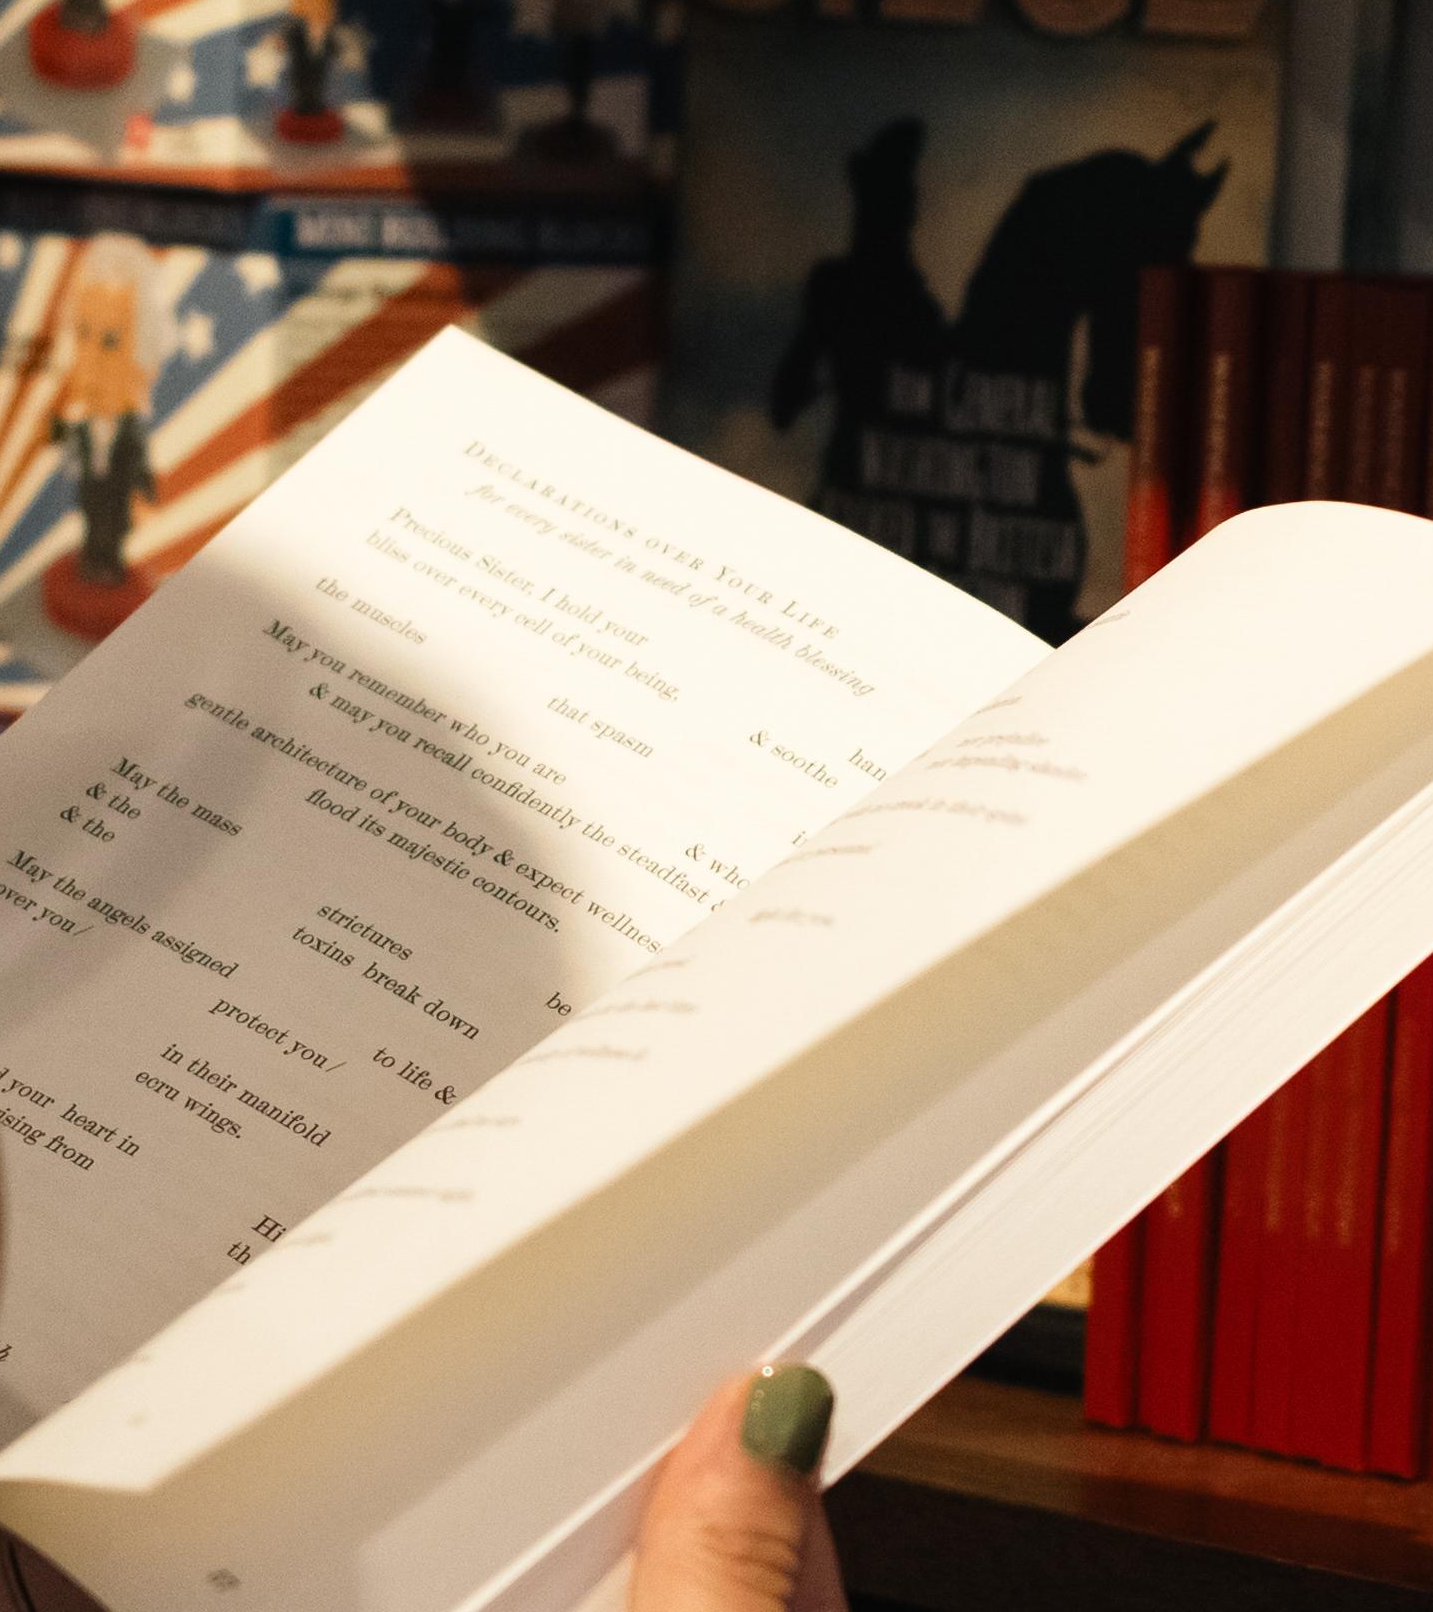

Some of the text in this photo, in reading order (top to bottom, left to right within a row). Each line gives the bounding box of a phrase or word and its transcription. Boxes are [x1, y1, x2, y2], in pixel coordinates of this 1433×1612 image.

[389, 506, 473, 561] Precious
[474, 555, 535, 596] Sister,
[553, 593, 604, 632] hold
[596, 620, 650, 647] your
[463, 440, 840, 640] DECLARATIONS OVER YOUR LIFE
[558, 532, 613, 560] sister
[613, 557, 638, 574] in
[639, 570, 692, 597] need
[687, 583, 717, 609] of
[729, 609, 795, 651] health
[794, 643, 876, 697] blessing
[262, 619, 310, 662] May
[303, 648, 347, 675] you
[346, 668, 448, 724] remember
[486, 741, 532, 769] you
[531, 762, 568, 786] are
[683, 842, 707, 863] &
[314, 576, 655, 759] the muscles that spasm
[365, 529, 410, 563] bliss
[412, 561, 459, 588] over
[513, 613, 554, 636] cell
[551, 632, 581, 656] of
[570, 642, 623, 670] your
[623, 660, 680, 702] being,
[747, 729, 770, 749] &
[769, 744, 839, 789] soothe
[84, 782, 414, 962] & the strictures
[110, 756, 157, 791] May
[155, 784, 190, 809] the
[190, 803, 243, 836] mass
[183, 693, 250, 730] gentle
[249, 726, 368, 792] architecture
[368, 788, 399, 812] of
[387, 791, 443, 829] your
[440, 820, 495, 858] body
[492, 848, 515, 868] &
[514, 862, 586, 906] expect
[586, 900, 665, 955] wellnes
[304, 788, 561, 934] flood its majestic contours.
[308, 682, 710, 905] & may you recall confidently the steadfast
[6, 849, 458, 1106] May the angels assigned to life &
[58, 805, 480, 1041] & the toxins break down
[134, 1071, 243, 1140] ecru wings.
[159, 1042, 333, 1148] in their manifold
[207, 998, 290, 1055] protect
[0, 1078, 56, 1109] your
[60, 1103, 117, 1146] heart
[117, 1137, 141, 1158] in
[43, 1134, 95, 1172] from
